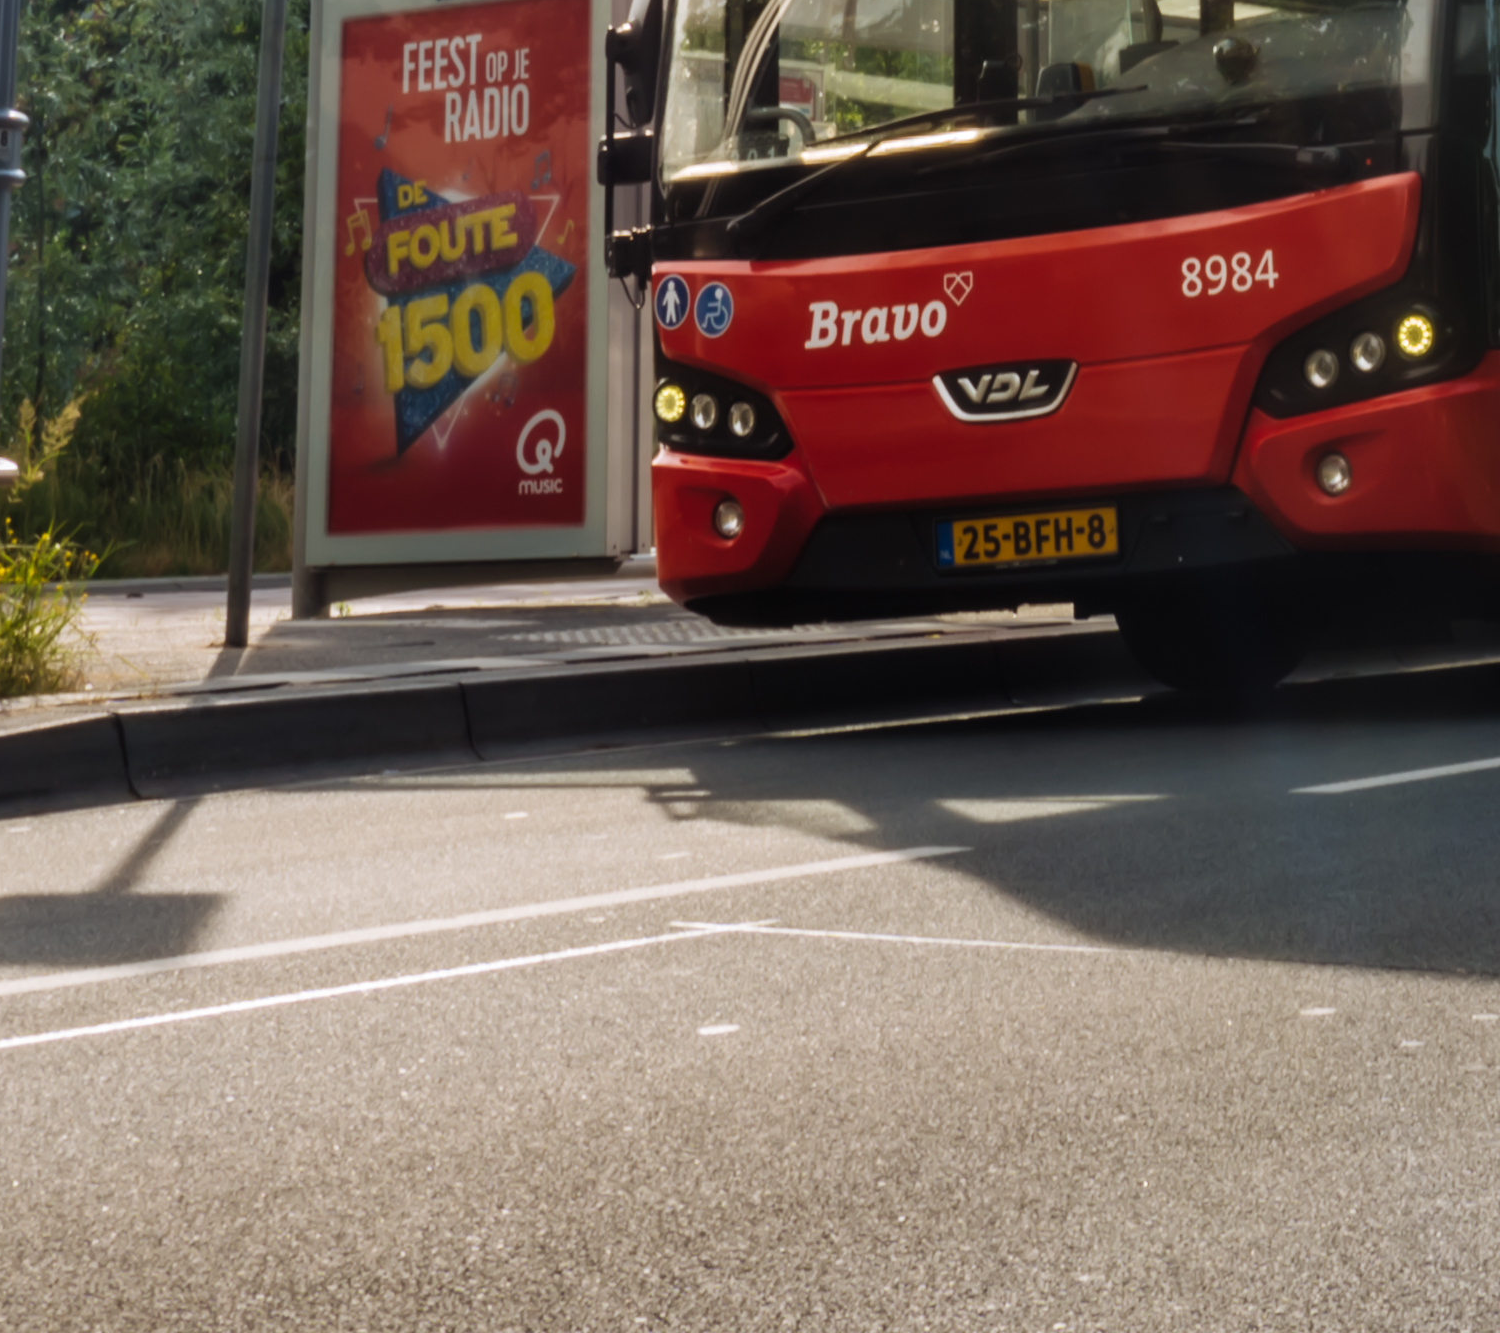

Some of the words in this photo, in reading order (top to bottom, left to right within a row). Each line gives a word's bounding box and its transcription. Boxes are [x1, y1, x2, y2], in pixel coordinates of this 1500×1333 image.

[403, 33, 482, 94] FEEST
[486, 51, 508, 83] OP
[513, 48, 530, 81] JE
[445, 83, 529, 144] RADIO
[397, 180, 428, 209] DE
[387, 203, 518, 277] FOUTE
[1181, 250, 1279, 298] 8984
[375, 271, 555, 395] 1500
[804, 299, 947, 350] Bravo
[957, 369, 1050, 404] VDL
[516, 409, 566, 475] Q
[962, 514, 1106, 561] 25-BFH-8
